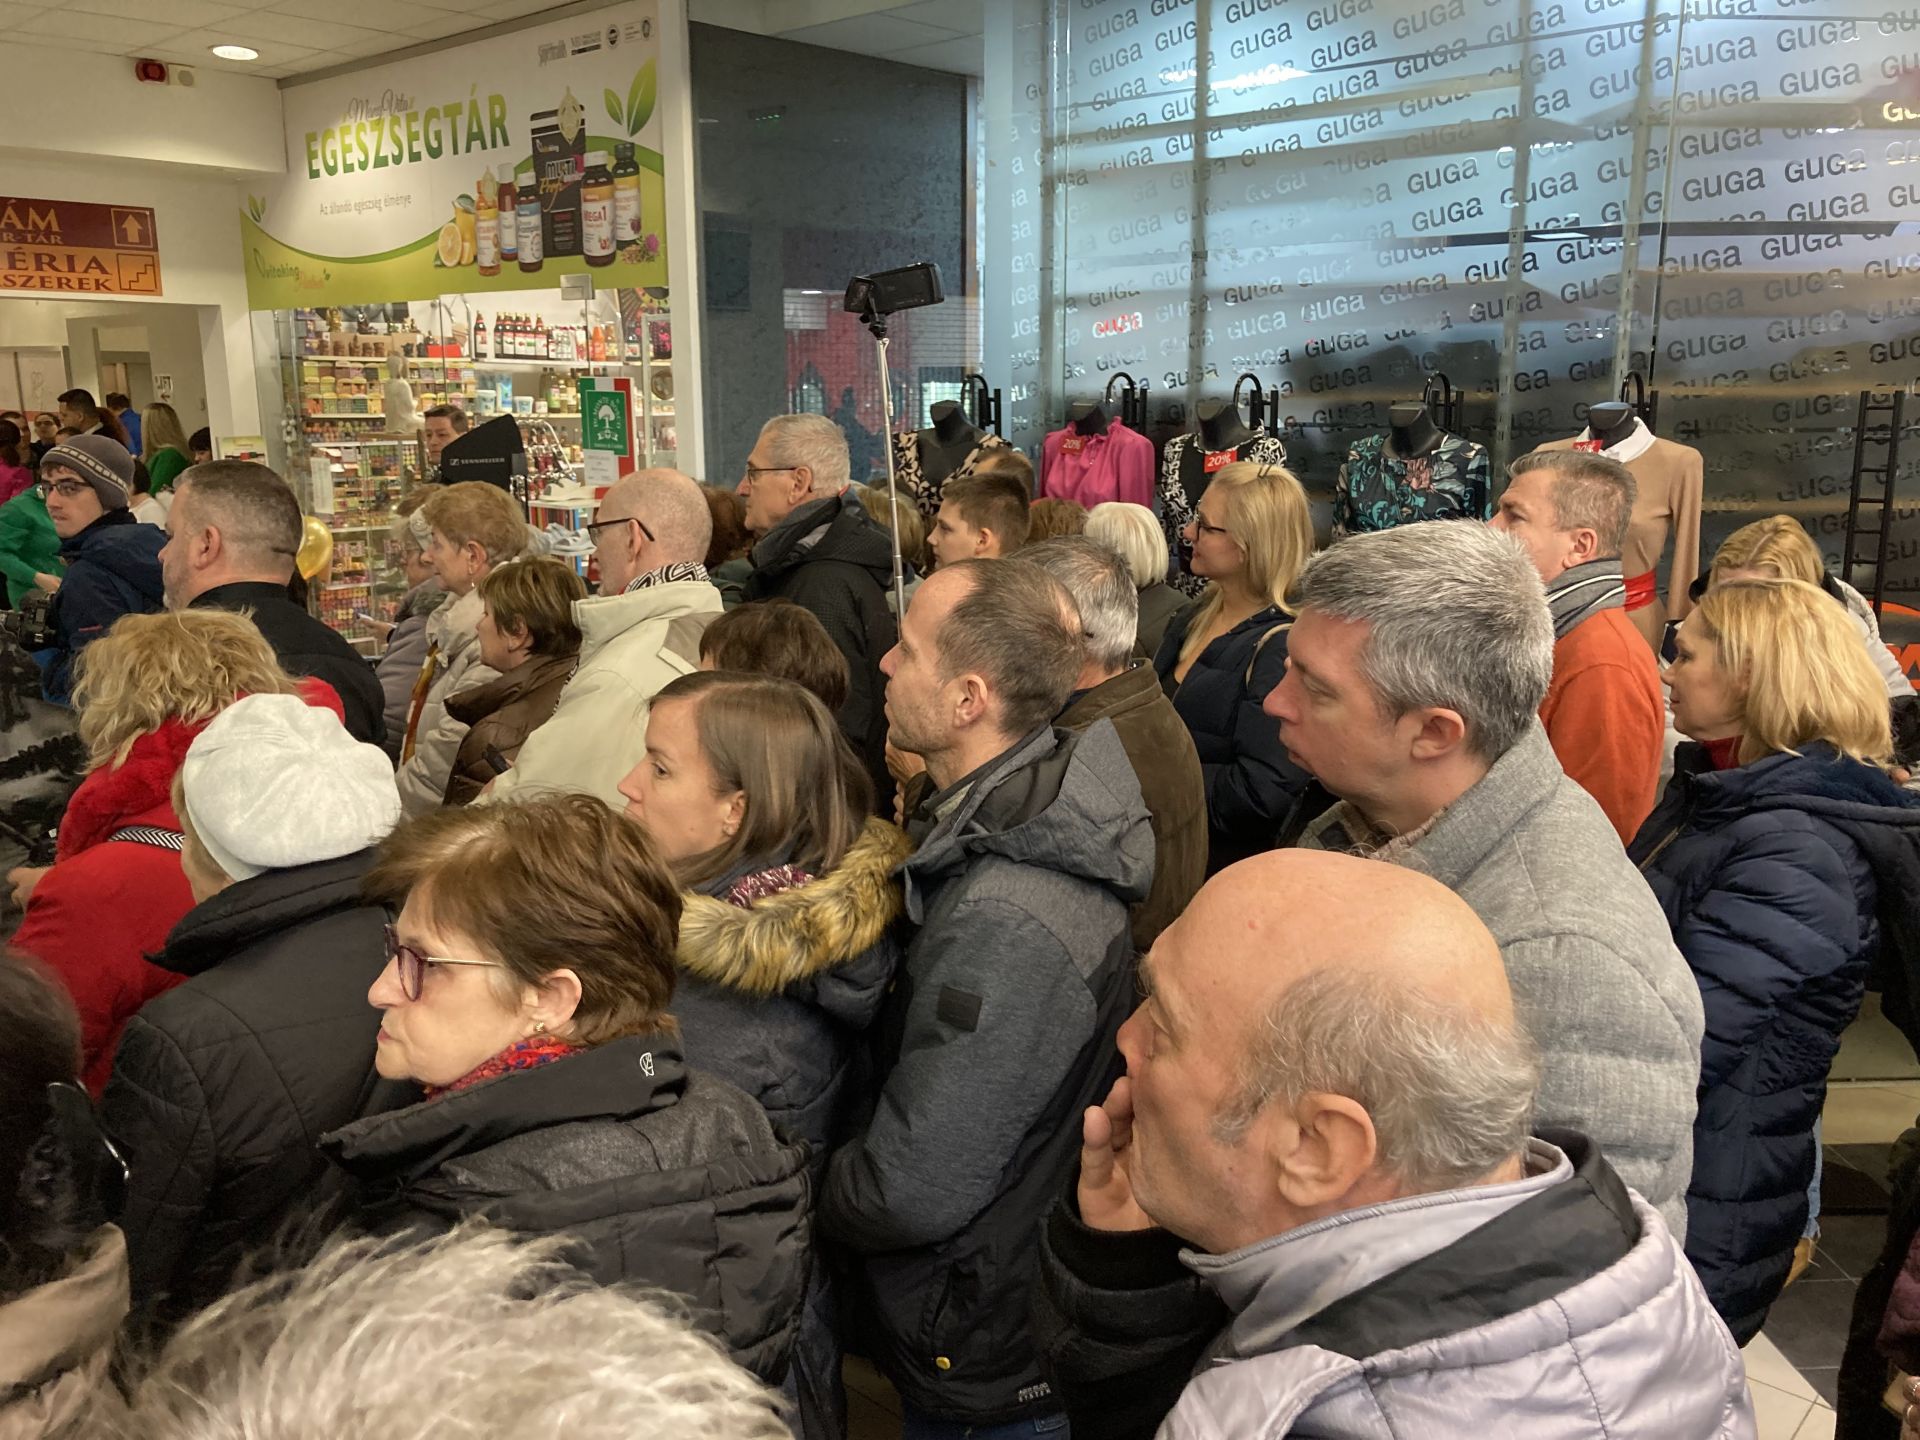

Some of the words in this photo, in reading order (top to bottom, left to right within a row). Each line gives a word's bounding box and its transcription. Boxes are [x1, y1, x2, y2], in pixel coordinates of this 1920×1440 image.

[0, 199, 63, 233] ÁM
[0, 246, 113, 275] ÉRIA
[0, 274, 117, 292] SZEREK
[1207, 452, 1231, 467] 20%
